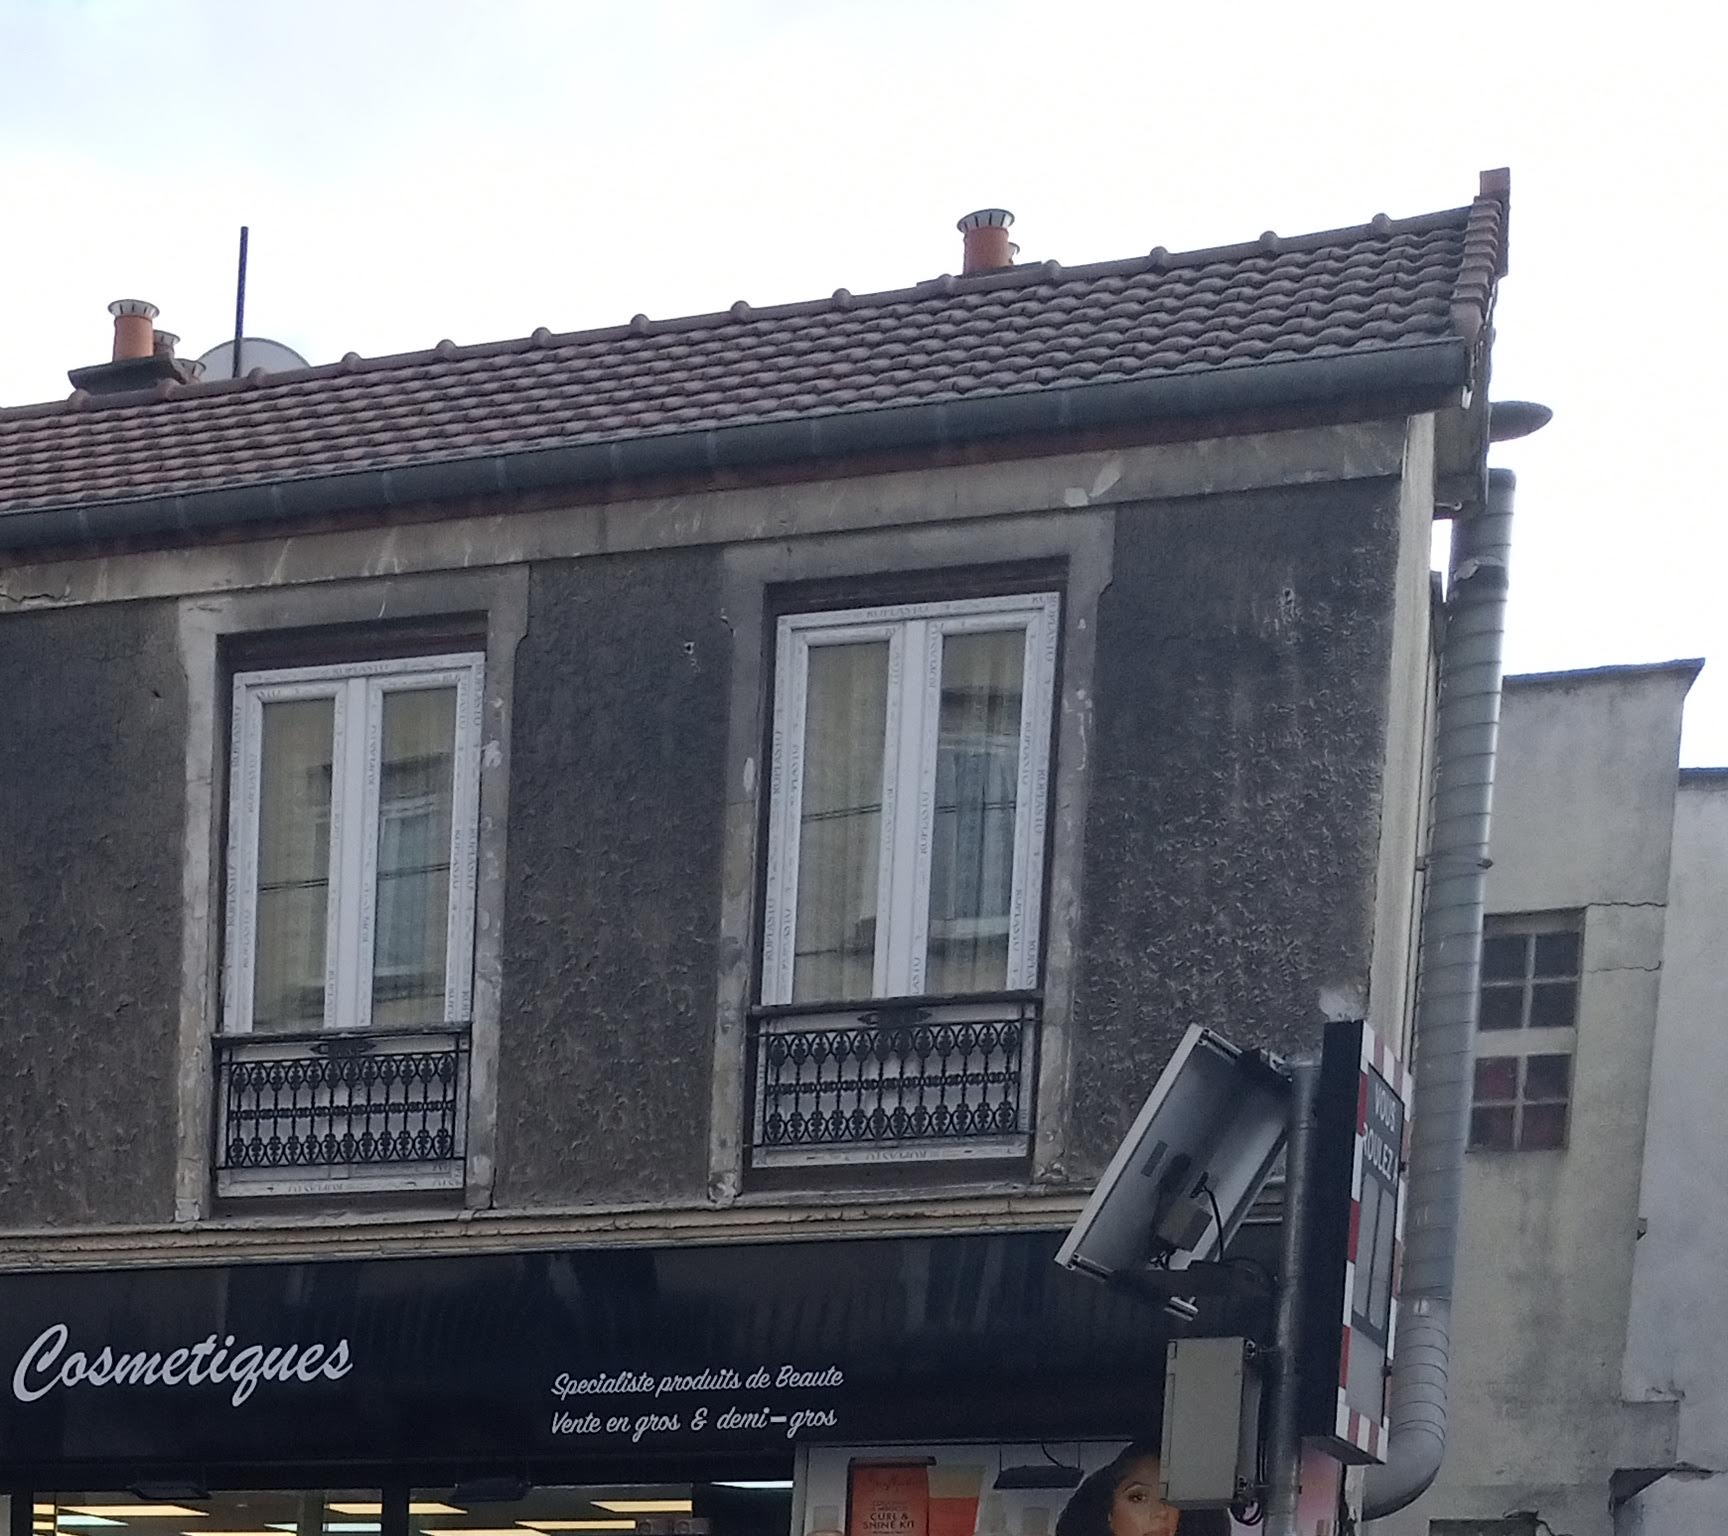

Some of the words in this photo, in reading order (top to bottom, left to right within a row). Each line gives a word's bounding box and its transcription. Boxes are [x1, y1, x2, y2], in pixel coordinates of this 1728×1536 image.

[1374, 1082, 1396, 1132] VOUS
[13, 1323, 354, 1406] Cosmetiques
[551, 1371, 655, 1400] Specialiste
[655, 1367, 741, 1398] produits
[745, 1366, 771, 1389] de
[775, 1364, 844, 1388] Beaute
[551, 1411, 602, 1434] Vente
[605, 1416, 631, 1432] en
[631, 1412, 681, 1443] gros
[690, 1407, 708, 1431] &
